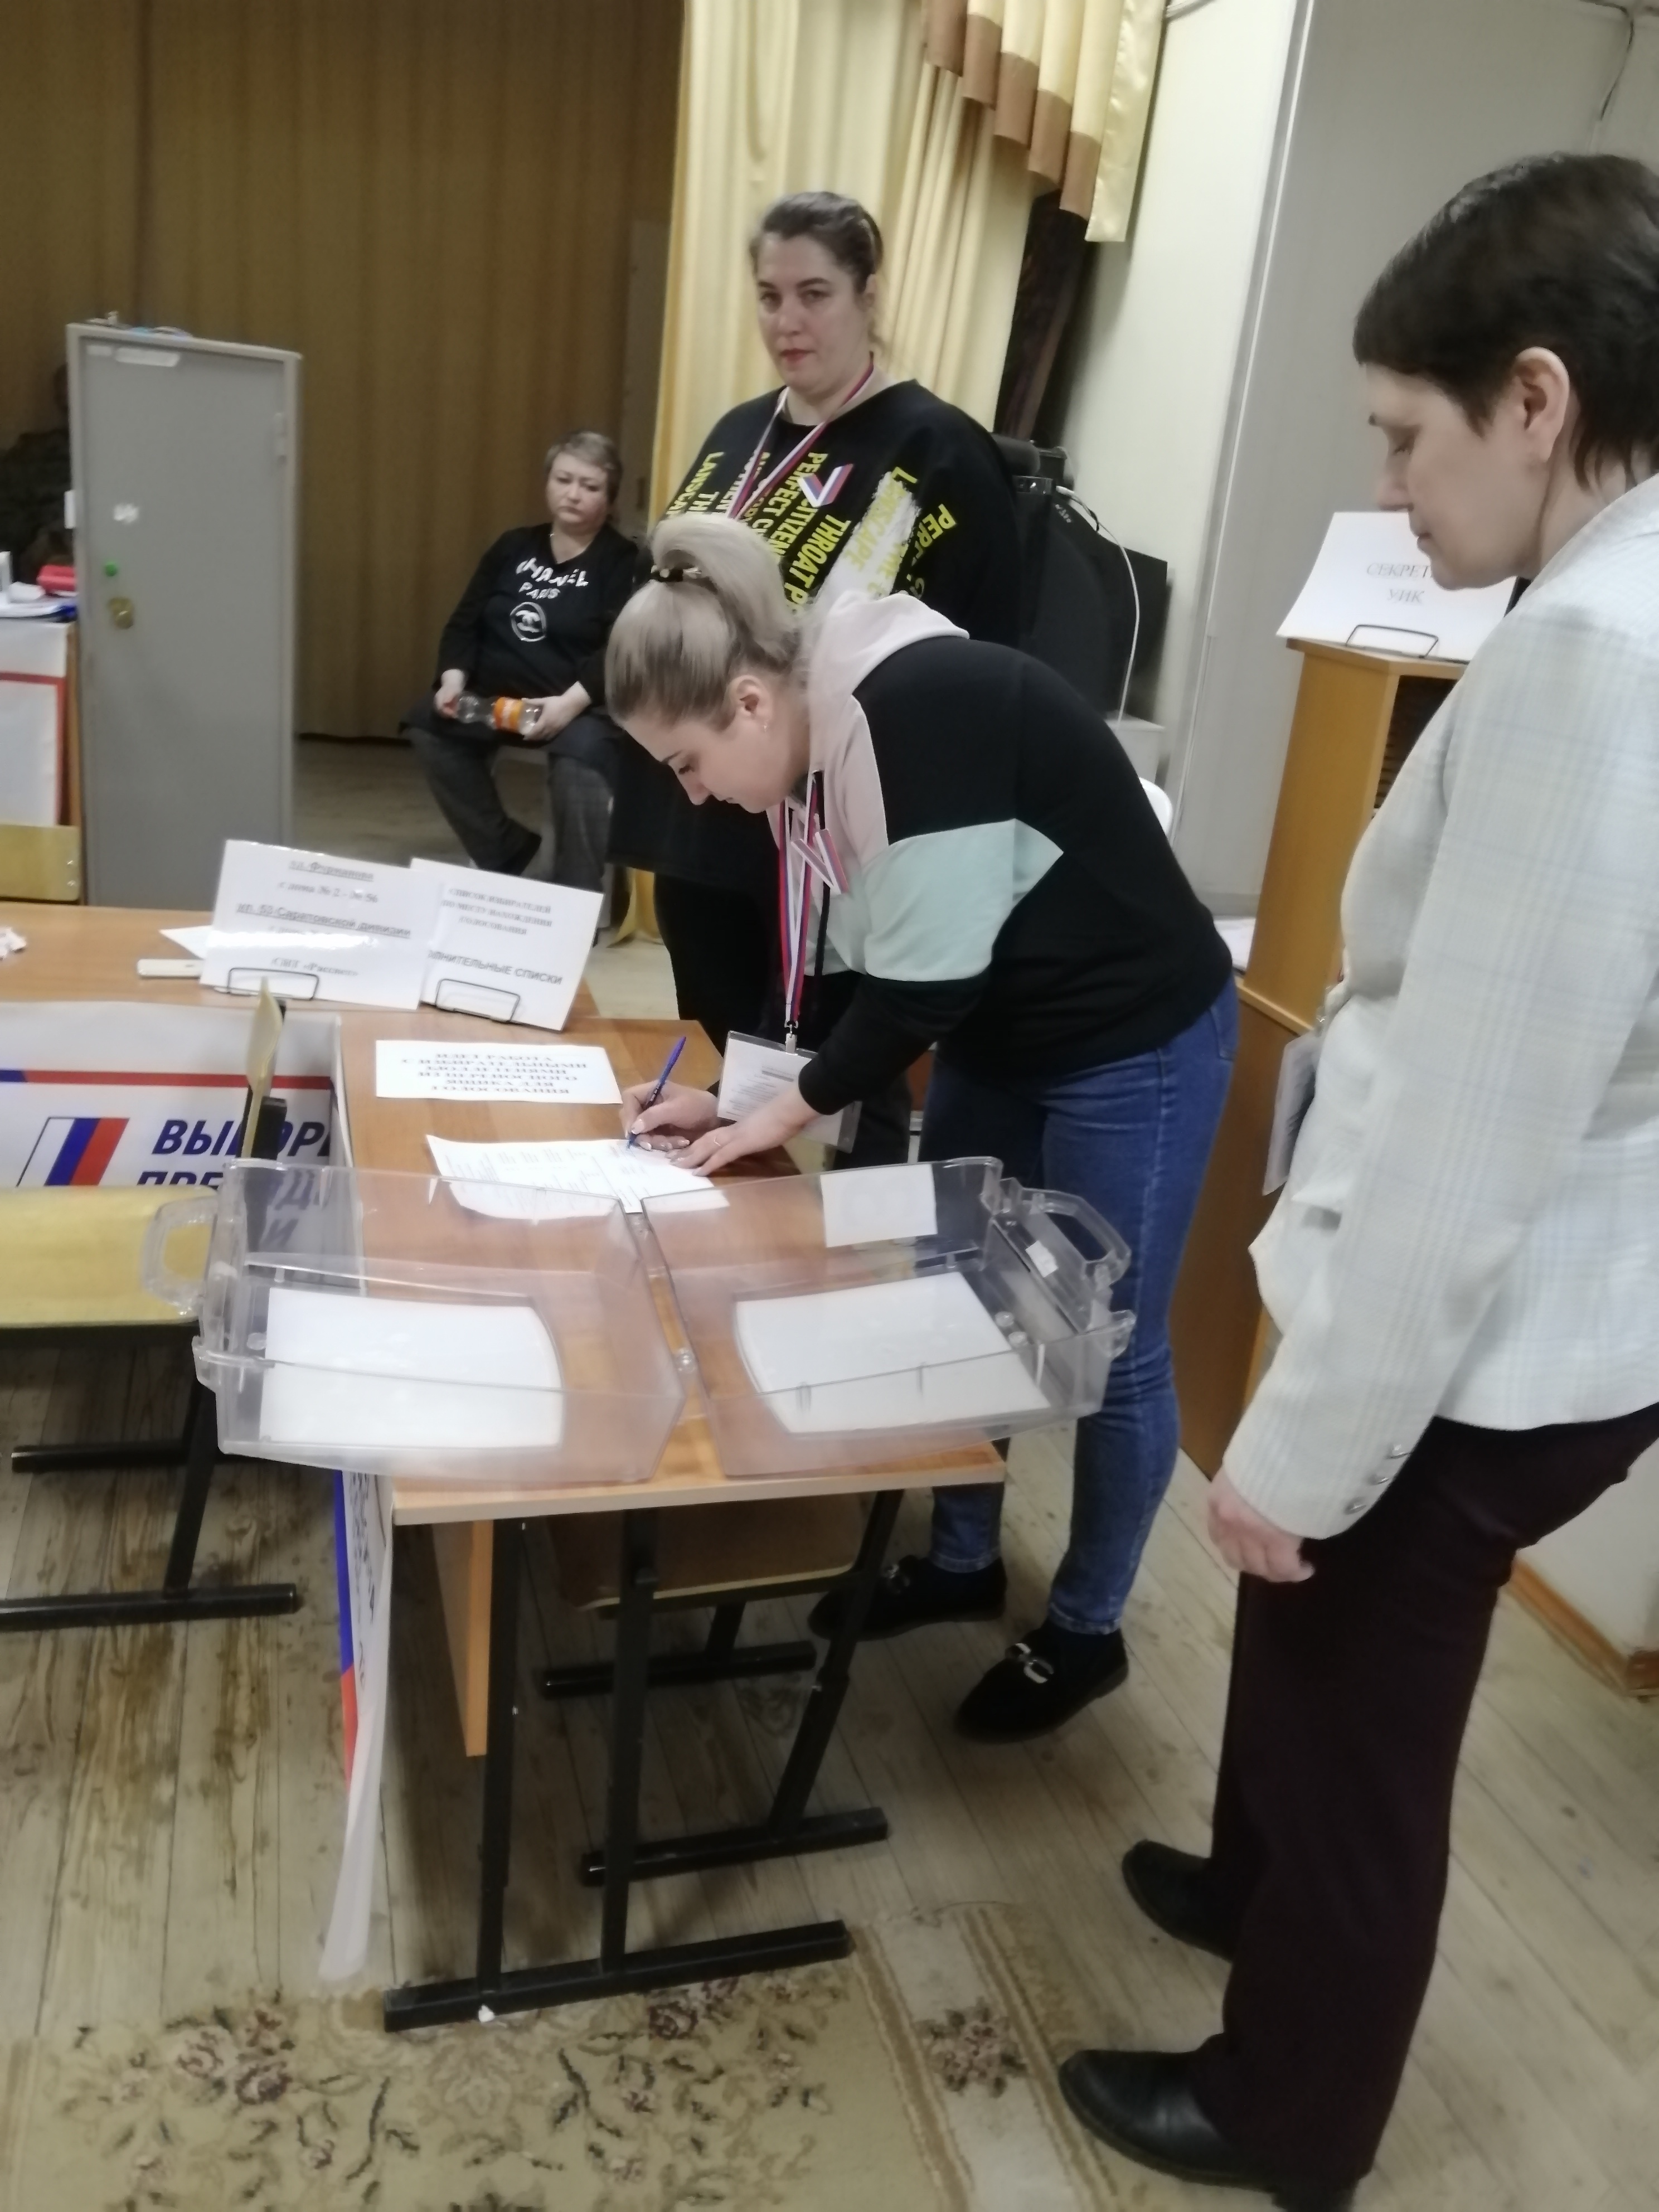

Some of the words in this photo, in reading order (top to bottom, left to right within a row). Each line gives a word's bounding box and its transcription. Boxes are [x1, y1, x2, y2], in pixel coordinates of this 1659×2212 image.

[666, 452, 725, 515] LANSCA
[789, 514, 852, 589] THROAT
[1367, 562, 1432, 578] СЕКРЕТ
[784, 582, 809, 604] P
[1387, 589, 1425, 603] УИК
[514, 968, 562, 985] СПИСКИ
